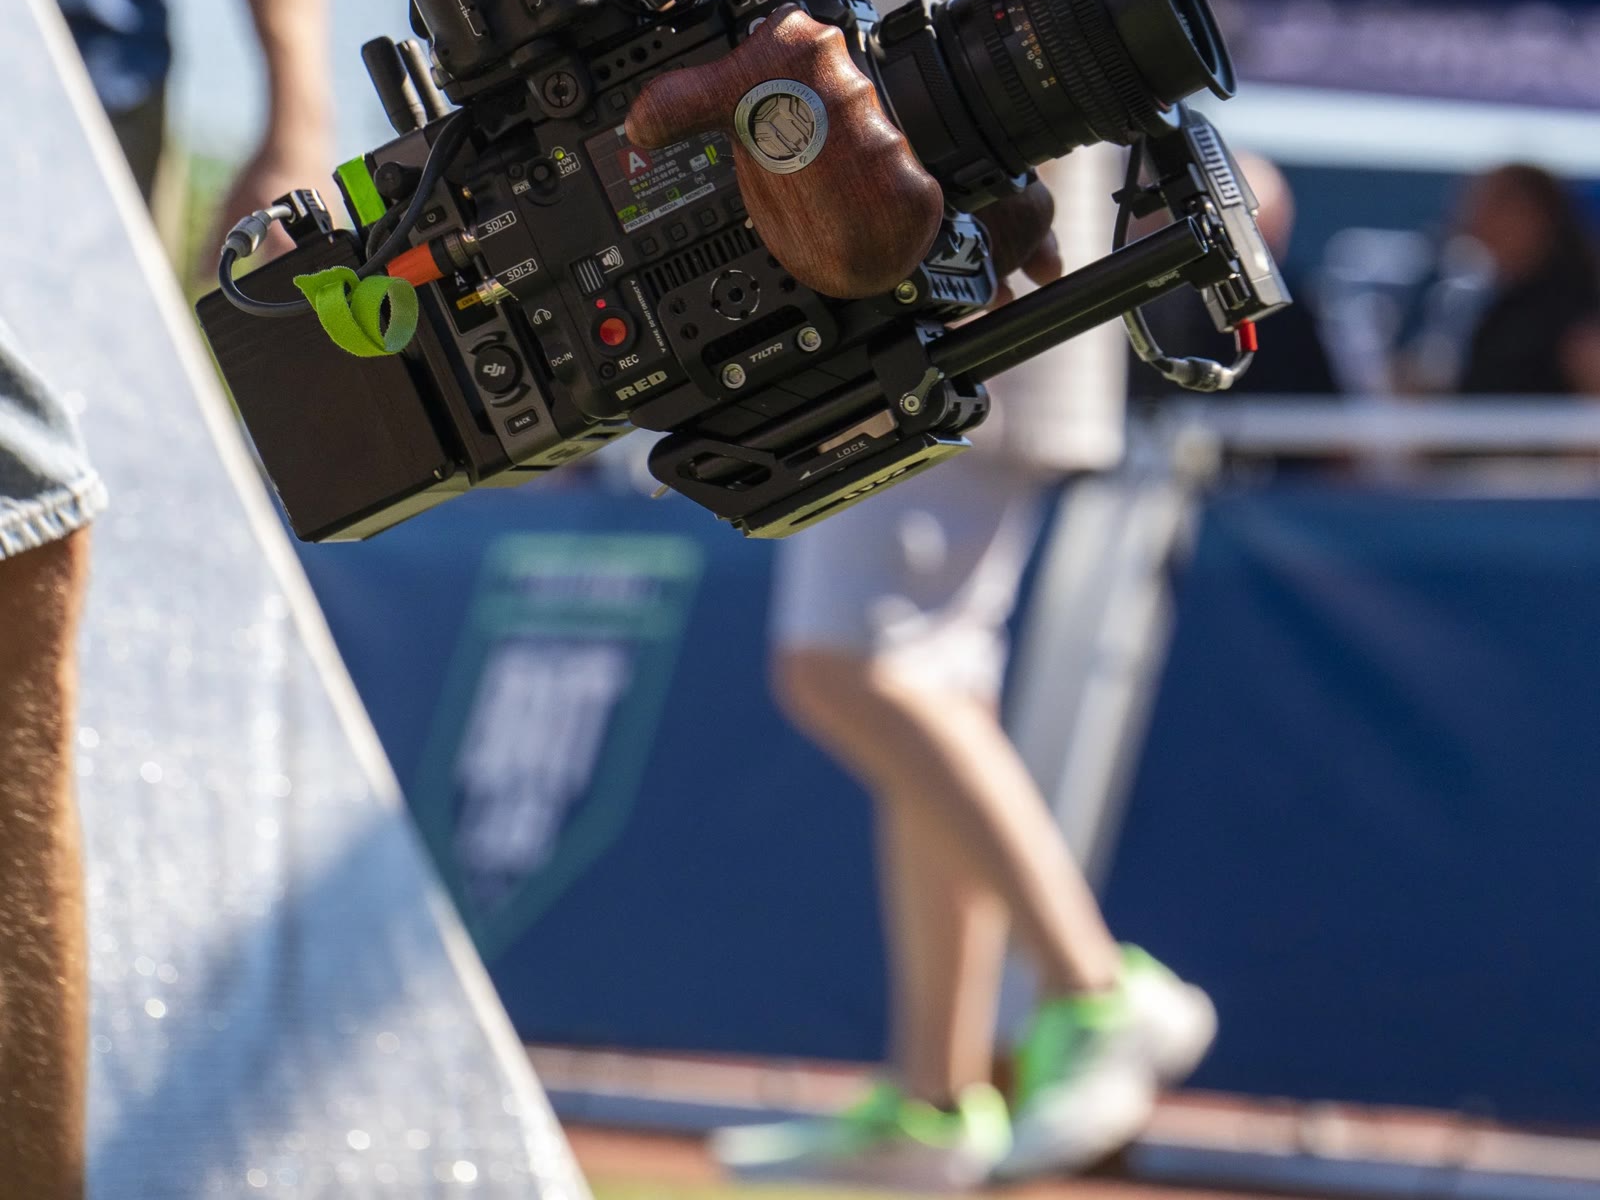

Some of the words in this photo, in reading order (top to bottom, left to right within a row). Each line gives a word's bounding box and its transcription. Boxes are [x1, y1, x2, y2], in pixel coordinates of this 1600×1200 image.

[1026, 50, 1035, 60] 10
[561, 157, 572, 167] ON
[563, 162, 578, 174] OFF
[629, 152, 647, 173] A
[659, 202, 679, 213] MEDIA
[485, 215, 513, 234] SDI-1
[626, 214, 651, 230] PROJECT
[506, 262, 533, 281] SDI-2
[551, 352, 573, 368] DC-IN
[749, 343, 783, 362] TILTA
[619, 354, 640, 370] REC
[615, 370, 668, 400] RED
[514, 415, 531, 428] BACK
[836, 440, 867, 458] LOCK
